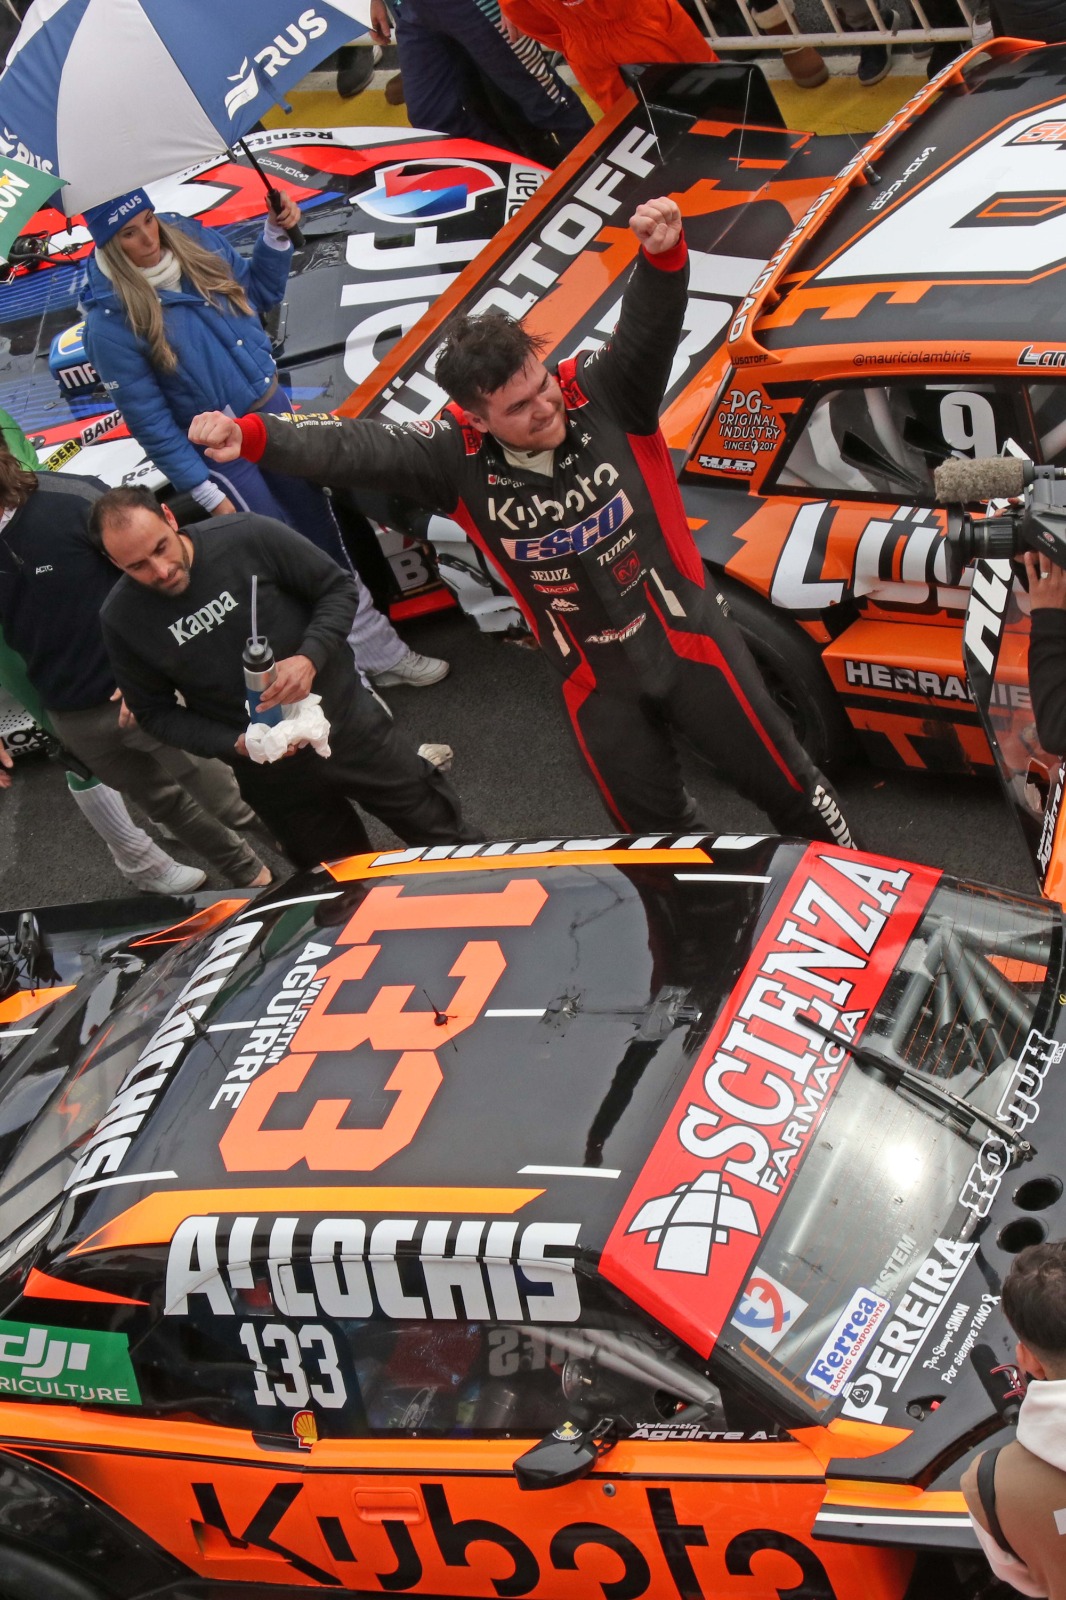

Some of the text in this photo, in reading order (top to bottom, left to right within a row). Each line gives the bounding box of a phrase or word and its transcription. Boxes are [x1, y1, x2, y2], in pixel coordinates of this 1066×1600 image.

[254, 9, 328, 77] RUS
[834, 144, 872, 182] DE
[119, 195, 143, 217] RUS
[727, 186, 836, 343] IDENTIDAD
[852, 350, 972, 367] @mauriciolambiris
[718, 412, 778, 428] ORIGINAL
[719, 426, 781, 440] INDUSTRY
[730, 390, 762, 414] PG
[939, 391, 998, 460] 9
[724, 440, 750, 451] SINCE
[488, 462, 620, 530] Kubota
[514, 495, 626, 560] ESCO
[530, 567, 571, 582] JELUZ
[167, 590, 239, 646] Kappa
[208, 942, 332, 1110] AGUIRRE
[218, 878, 550, 1172] 133
[265, 978, 327, 1064] VALENTIN
[677, 853, 913, 1189] SCIENZA
[64, 920, 264, 1191] ALLOCHIS
[761, 1009, 867, 1195] FARMACIA
[164, 1215, 582, 1322] ALLOCHIS
[811, 1296, 878, 1385] Ferrea
[829, 1302, 886, 1392] RACING COMPONENTS
[841, 1237, 976, 1425] PEREIRA
[941, 1304, 992, 1385] Por siempre TANO
[945, 1302, 971, 1333] SIMON
[239, 1322, 348, 1409] 133
[629, 1427, 745, 1442] Aguirre
[635, 1422, 701, 1431] Valentin
